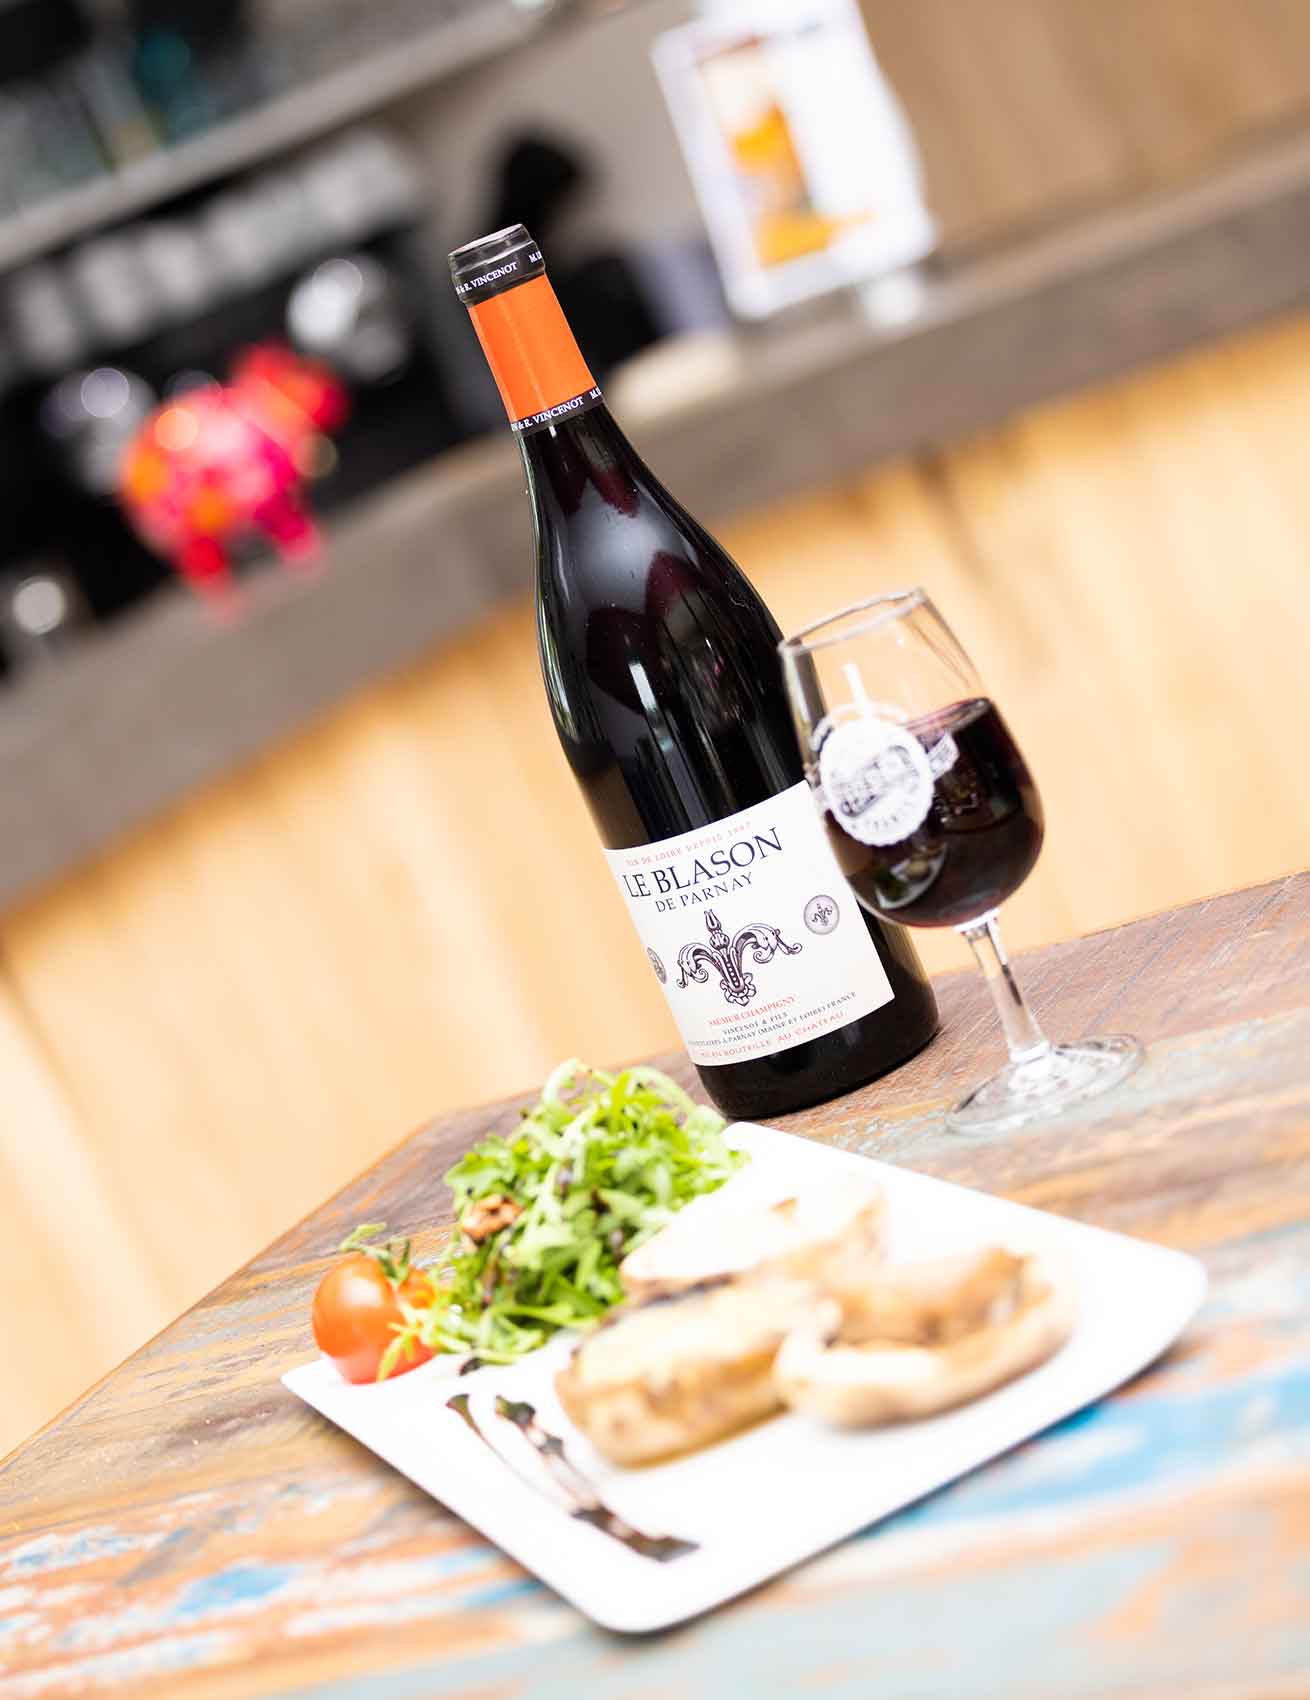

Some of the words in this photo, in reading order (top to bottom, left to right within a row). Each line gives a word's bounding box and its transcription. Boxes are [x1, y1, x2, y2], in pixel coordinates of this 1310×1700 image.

[471, 262, 517, 288] VINCENOT
[533, 396, 584, 424] VINCENOT
[622, 873, 651, 897] LE
[651, 826, 782, 894] BLASON
[655, 897, 677, 912] DE
[680, 872, 752, 906] PARNAY
[728, 1029, 757, 1042] PARNAY
[788, 1016, 797, 1025] ET
[827, 991, 856, 1009] FRANCE
[741, 996, 795, 1018] CHAMPIGNY
[722, 1020, 759, 1035] VINCENOT
[770, 1011, 788, 1022] FILS
[723, 1039, 770, 1056] BOUTEILLE
[777, 1032, 792, 1042] AU
